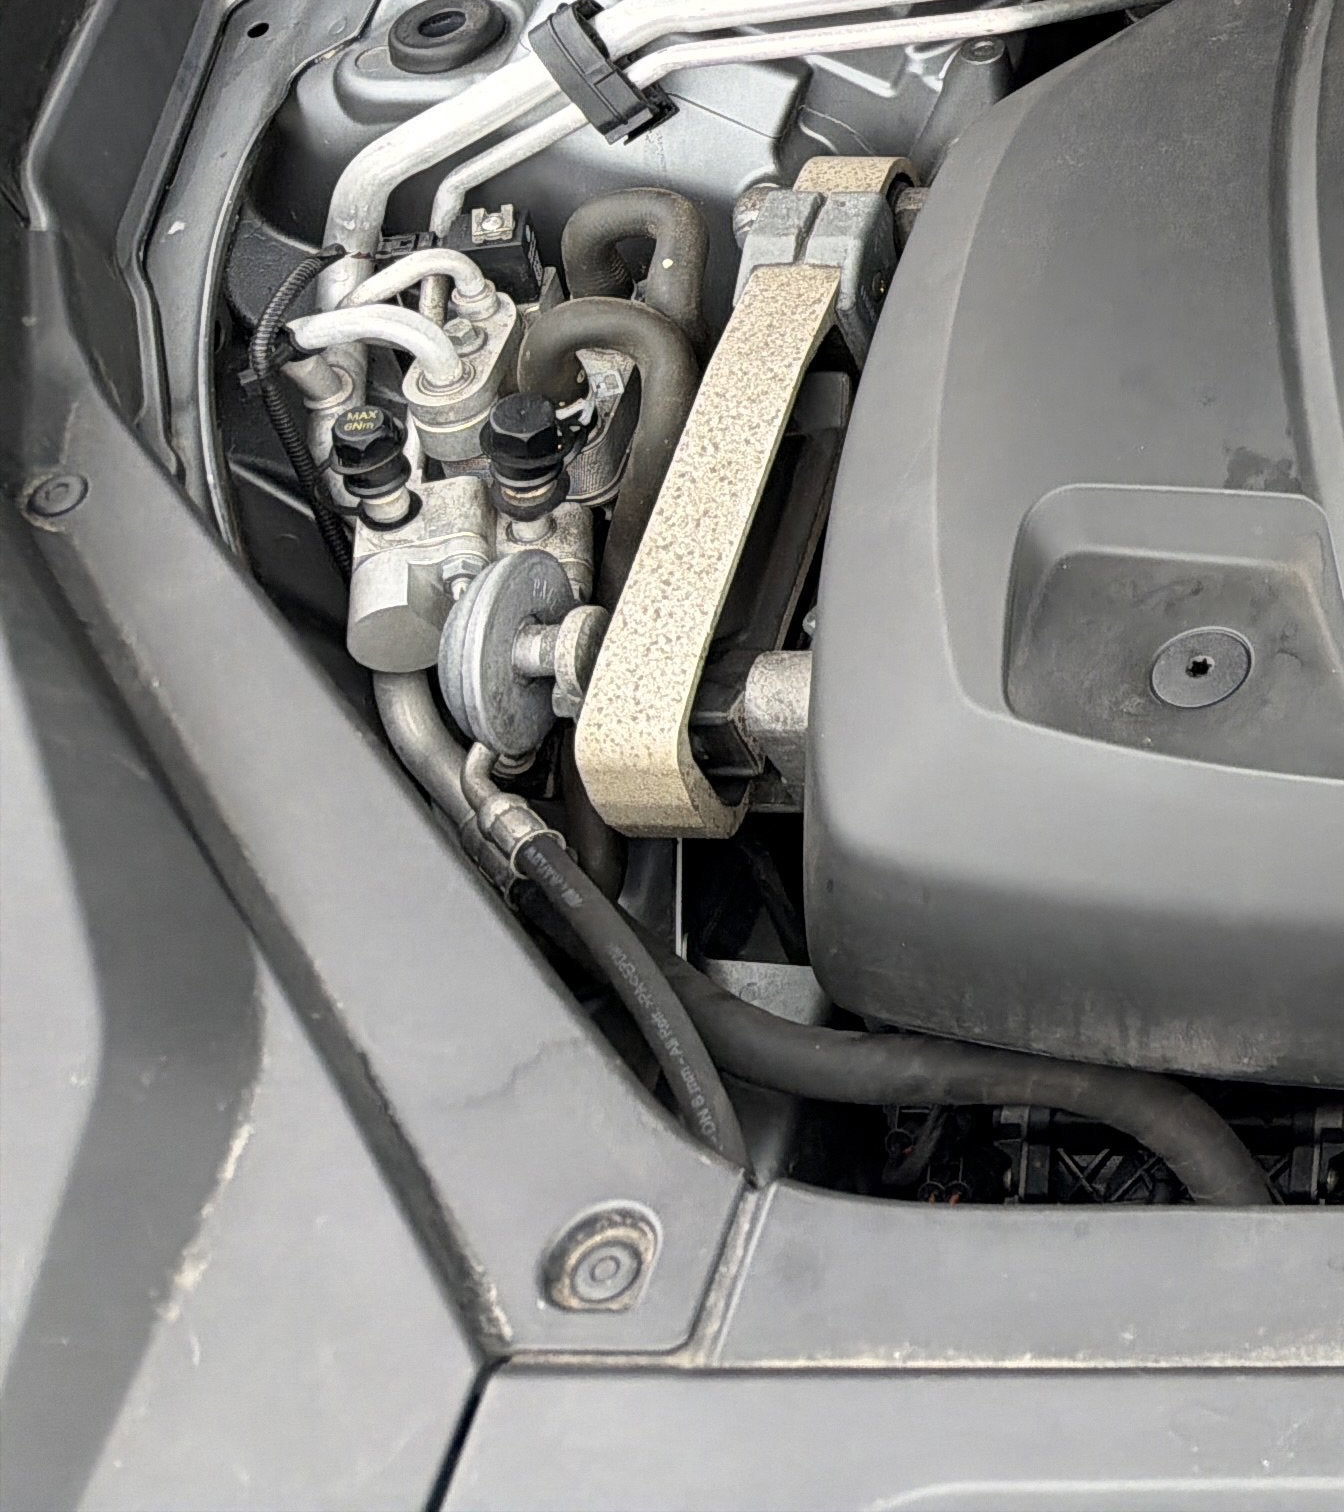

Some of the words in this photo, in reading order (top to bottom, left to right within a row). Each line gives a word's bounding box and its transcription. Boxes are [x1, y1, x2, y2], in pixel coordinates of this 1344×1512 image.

[347, 410, 378, 421] MAX
[344, 421, 375, 431] 6Nm
[697, 1108, 716, 1135] DN
